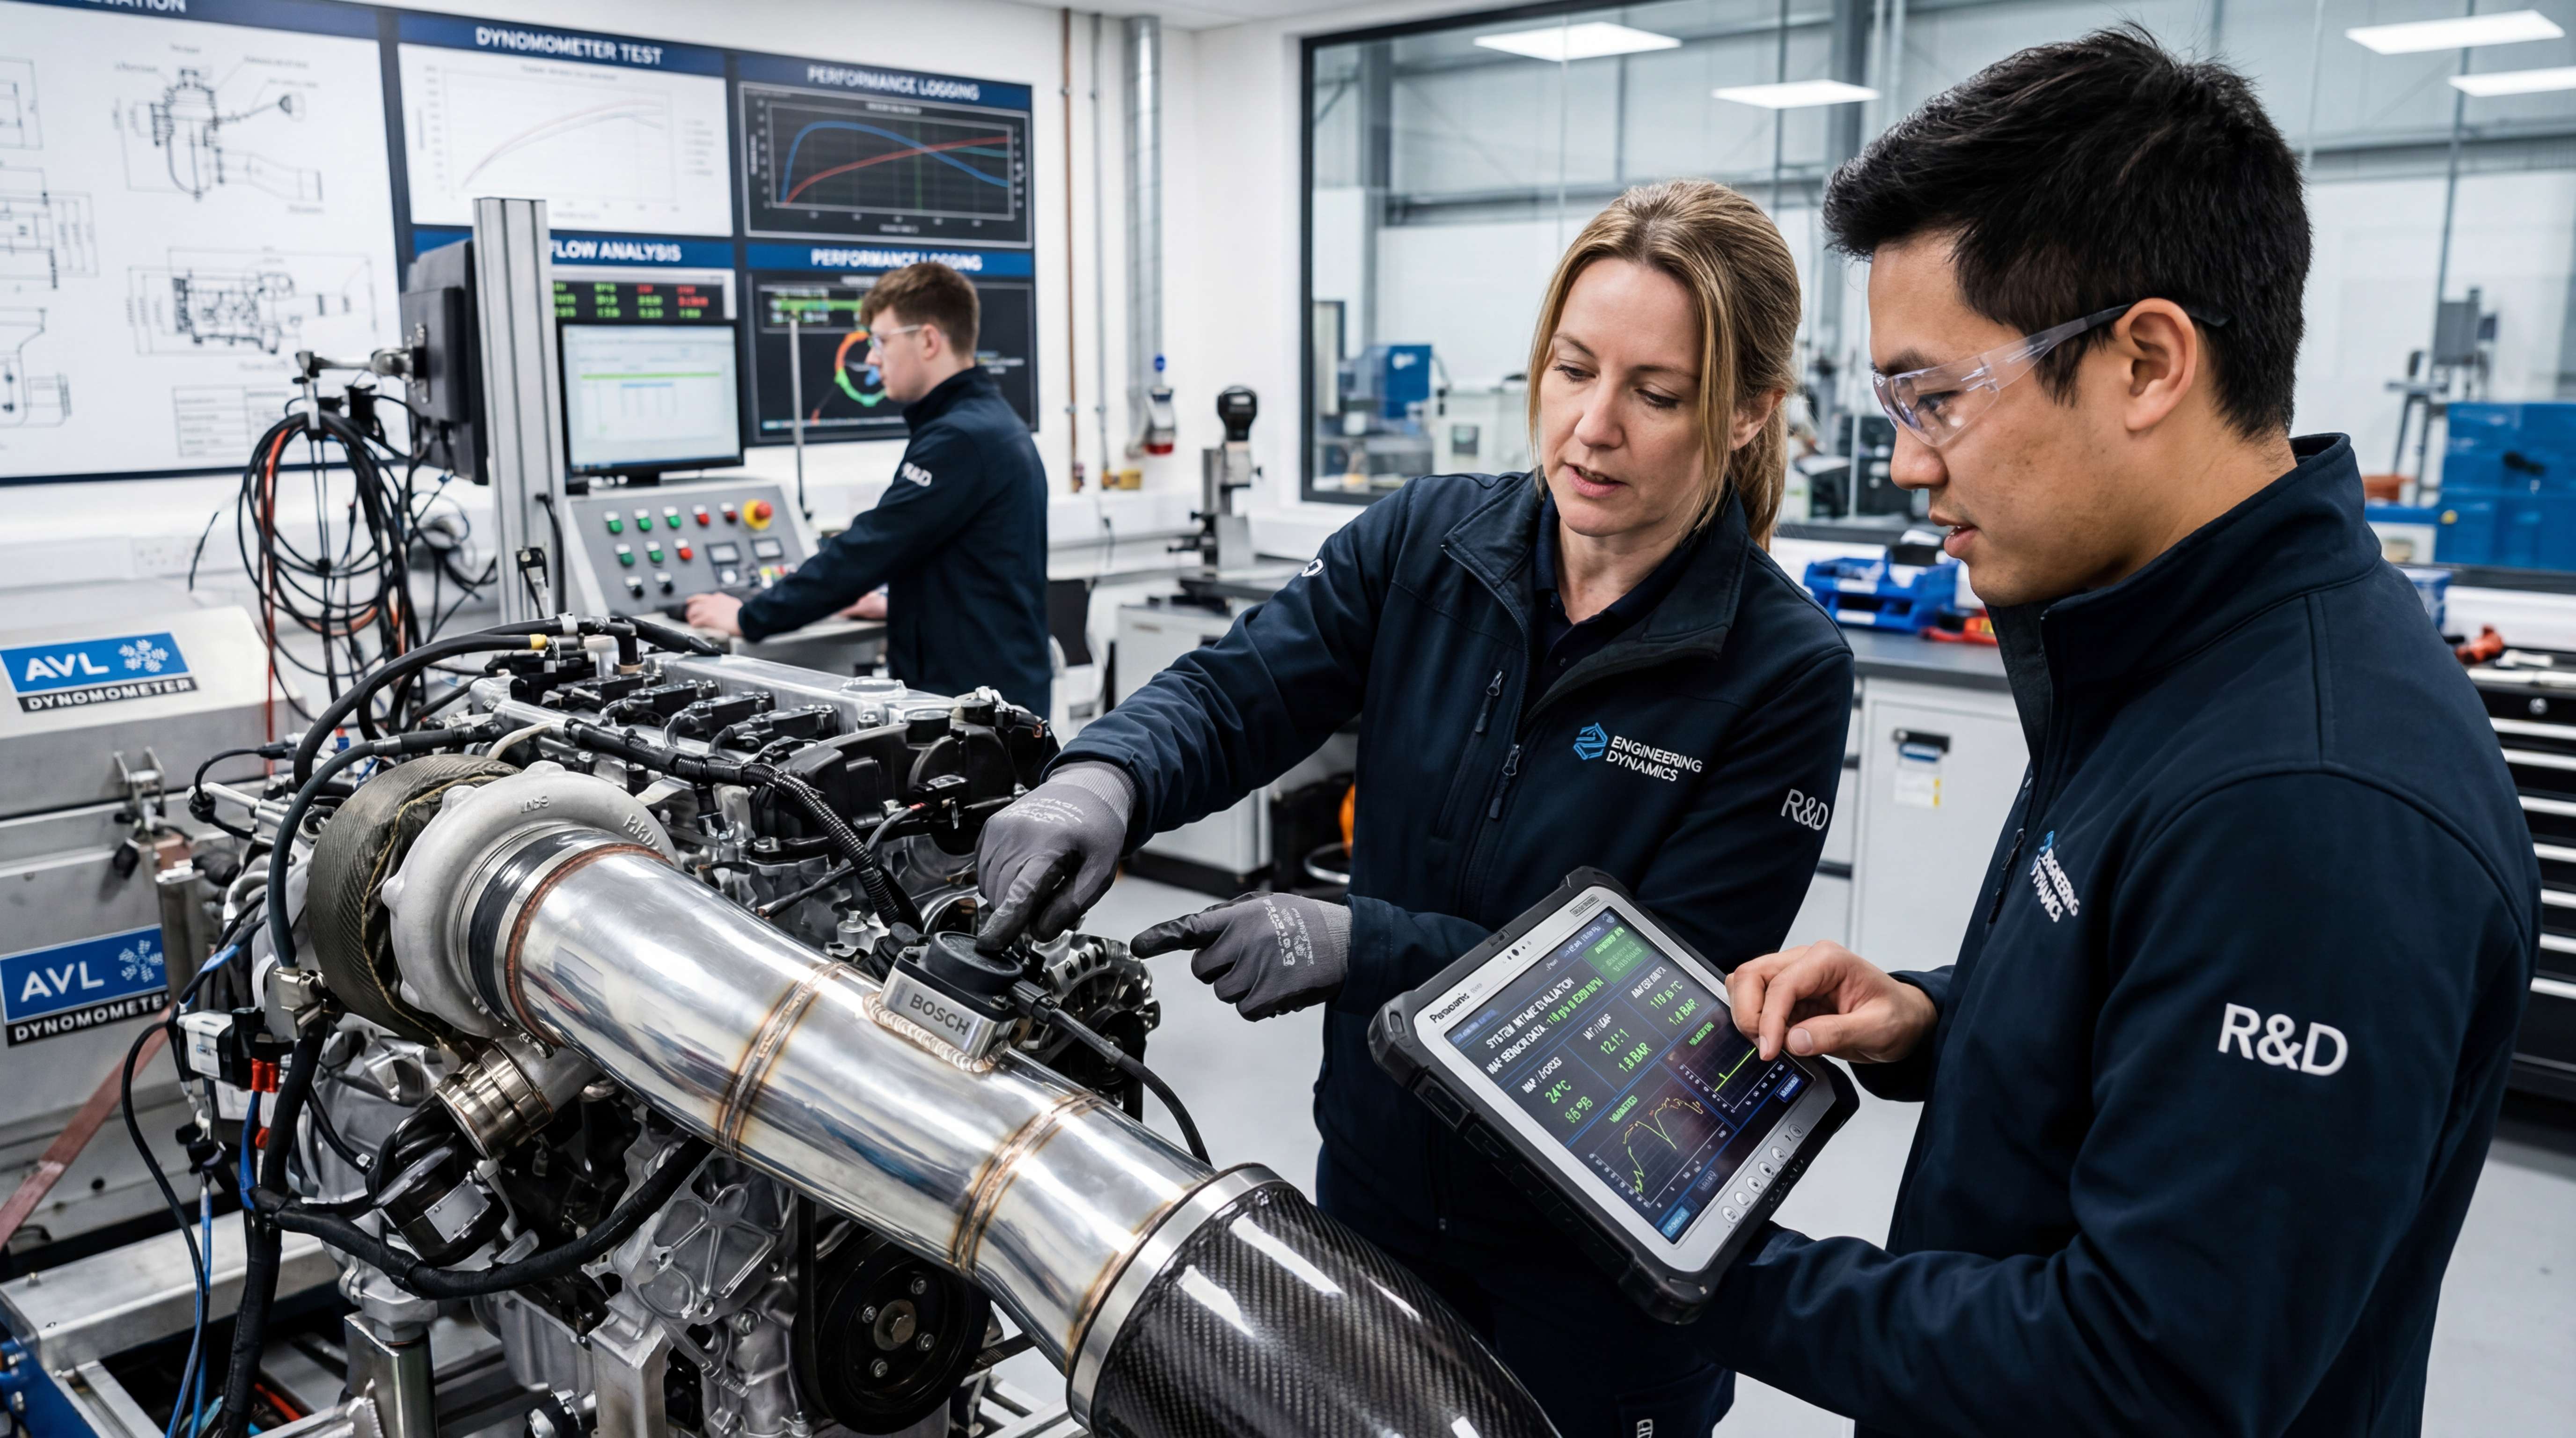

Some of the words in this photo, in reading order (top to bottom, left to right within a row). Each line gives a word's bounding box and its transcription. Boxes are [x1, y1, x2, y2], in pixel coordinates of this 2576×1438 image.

[475, 26, 617, 61] DYNOMOMETER
[619, 43, 663, 65] TEST
[807, 65, 916, 94] PERFORMANCE
[918, 79, 980, 101] LOGGING
[600, 241, 681, 262] ANALYSIS
[811, 248, 919, 268] PERFORMANCE
[25, 652, 110, 682] AVL
[27, 679, 192, 711] DYNOMOMETER
[1606, 749, 1678, 782] DYNAMICS
[1610, 735, 1703, 773] ENGINEERING
[1781, 789, 1828, 831] R&D
[21, 961, 104, 1002] AVL
[909, 992, 971, 1036] BOSCH
[1679, 998, 1699, 1016] BAR
[1629, 1042, 1652, 1063] BAR
[2218, 1003, 2348, 1076] R&D
